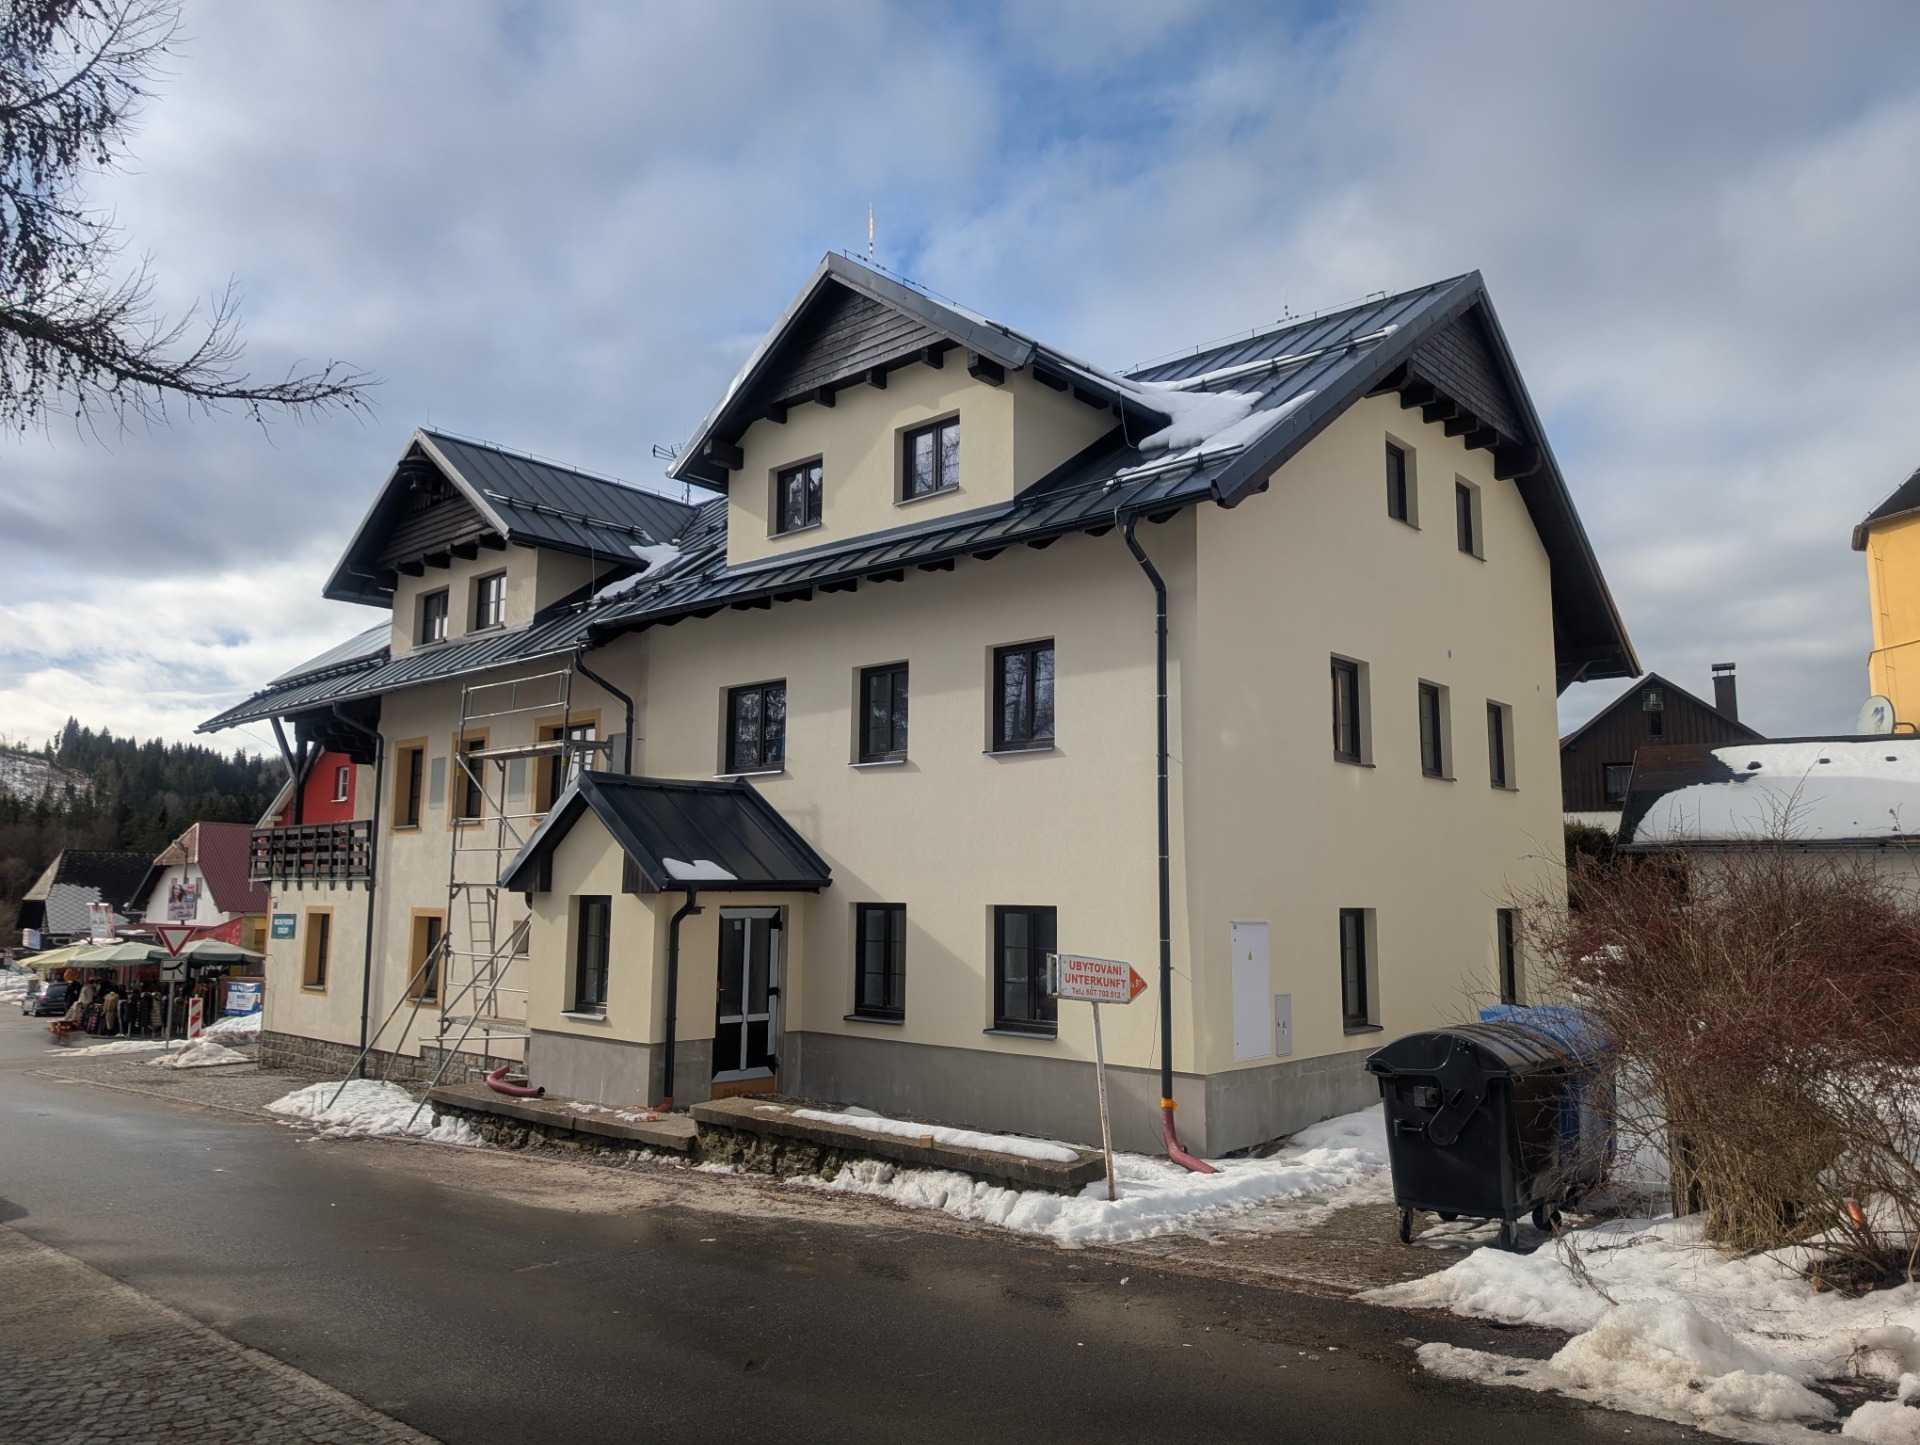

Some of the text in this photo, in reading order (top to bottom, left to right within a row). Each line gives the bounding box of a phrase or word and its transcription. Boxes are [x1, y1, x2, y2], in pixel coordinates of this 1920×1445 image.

[1069, 960, 1122, 975] UBYTOVÁNÍ
[1064, 973, 1127, 989] UNTERKUNFT
[1085, 988, 1097, 996] 607
[1098, 989, 1109, 997] 702
